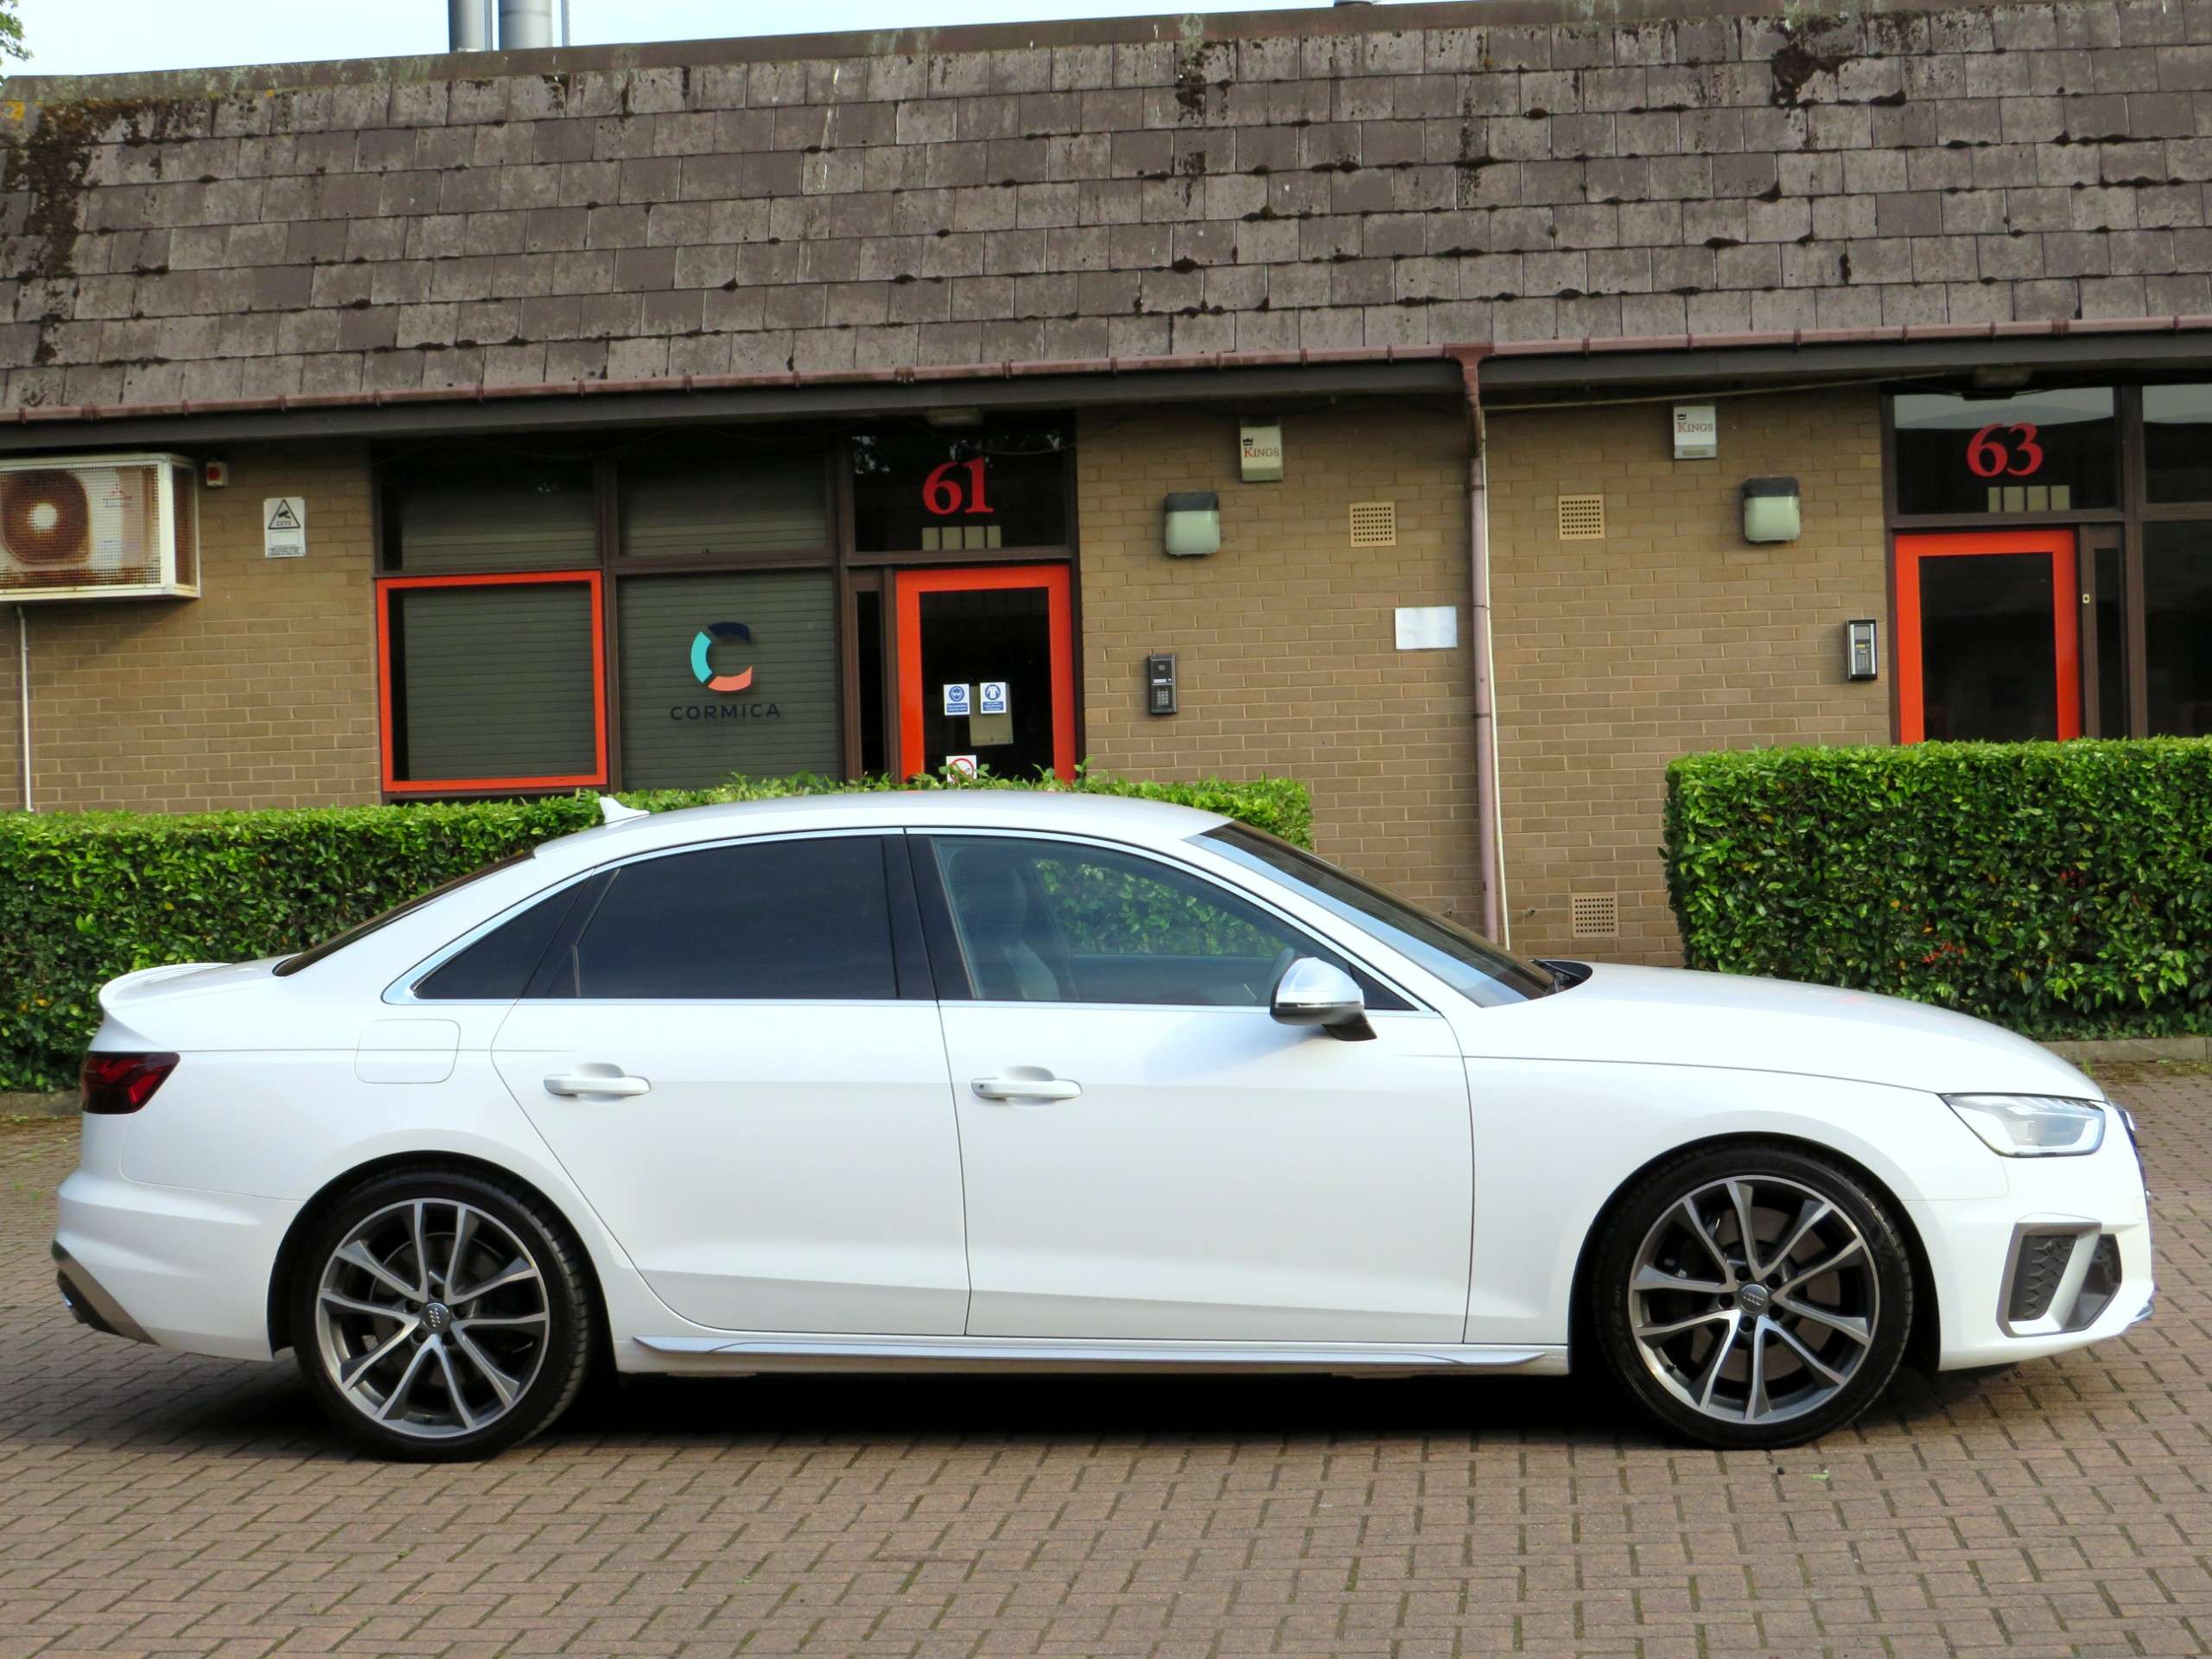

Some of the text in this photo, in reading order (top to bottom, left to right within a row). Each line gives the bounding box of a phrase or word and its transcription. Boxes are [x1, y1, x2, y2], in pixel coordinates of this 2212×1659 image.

[1676, 422, 1713, 433] KINGS
[1244, 447, 1280, 458] KINGS
[1967, 423, 2043, 476] 63
[923, 456, 994, 514] 61
[670, 703, 780, 721] CORMICA
